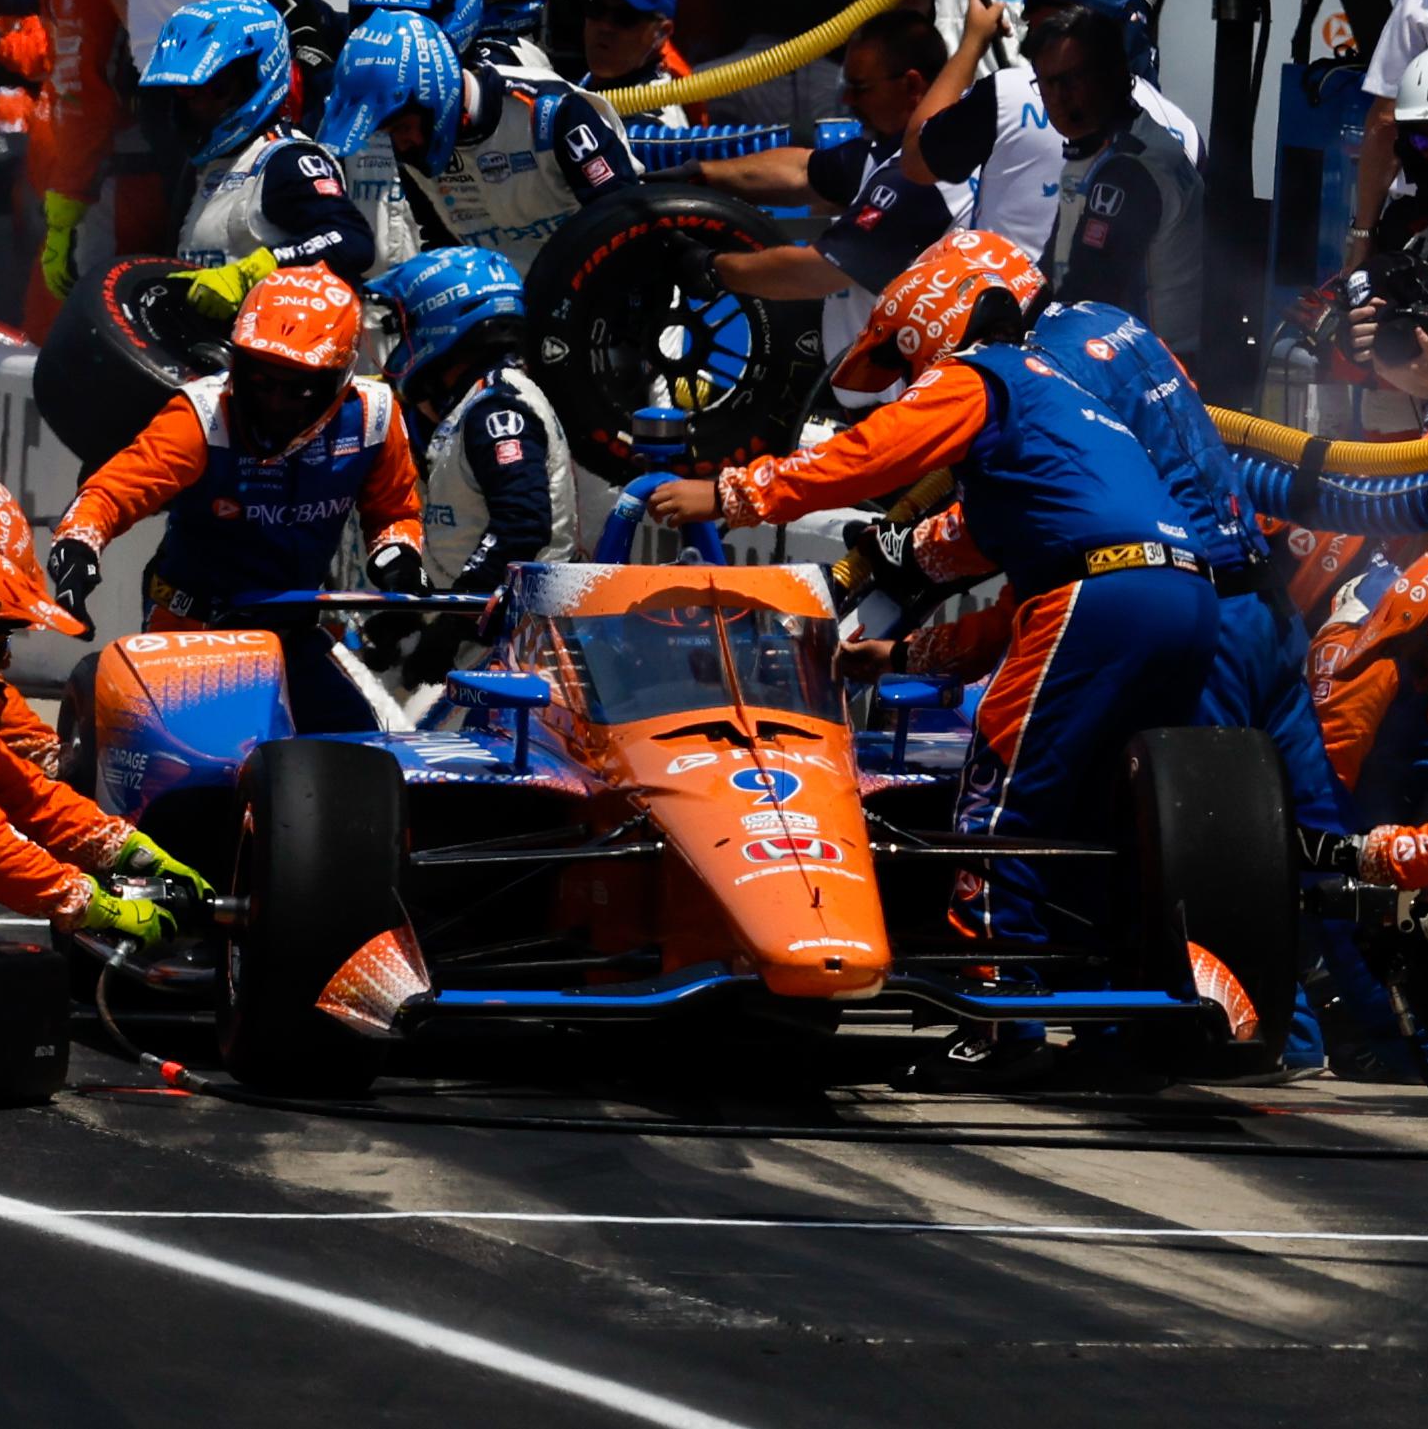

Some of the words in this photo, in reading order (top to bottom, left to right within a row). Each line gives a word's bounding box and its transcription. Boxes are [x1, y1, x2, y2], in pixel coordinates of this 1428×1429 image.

[427, 281, 470, 311] DATA
[896, 272, 925, 300] PNC
[908, 269, 957, 325] PNC
[273, 295, 308, 307] PNC
[940, 296, 973, 325] PNC
[269, 340, 303, 361] PNC
[173, 632, 267, 649] PNC
[459, 688, 488, 706] PNC
[122, 772, 144, 790] XYZ
[729, 767, 803, 805] 9
